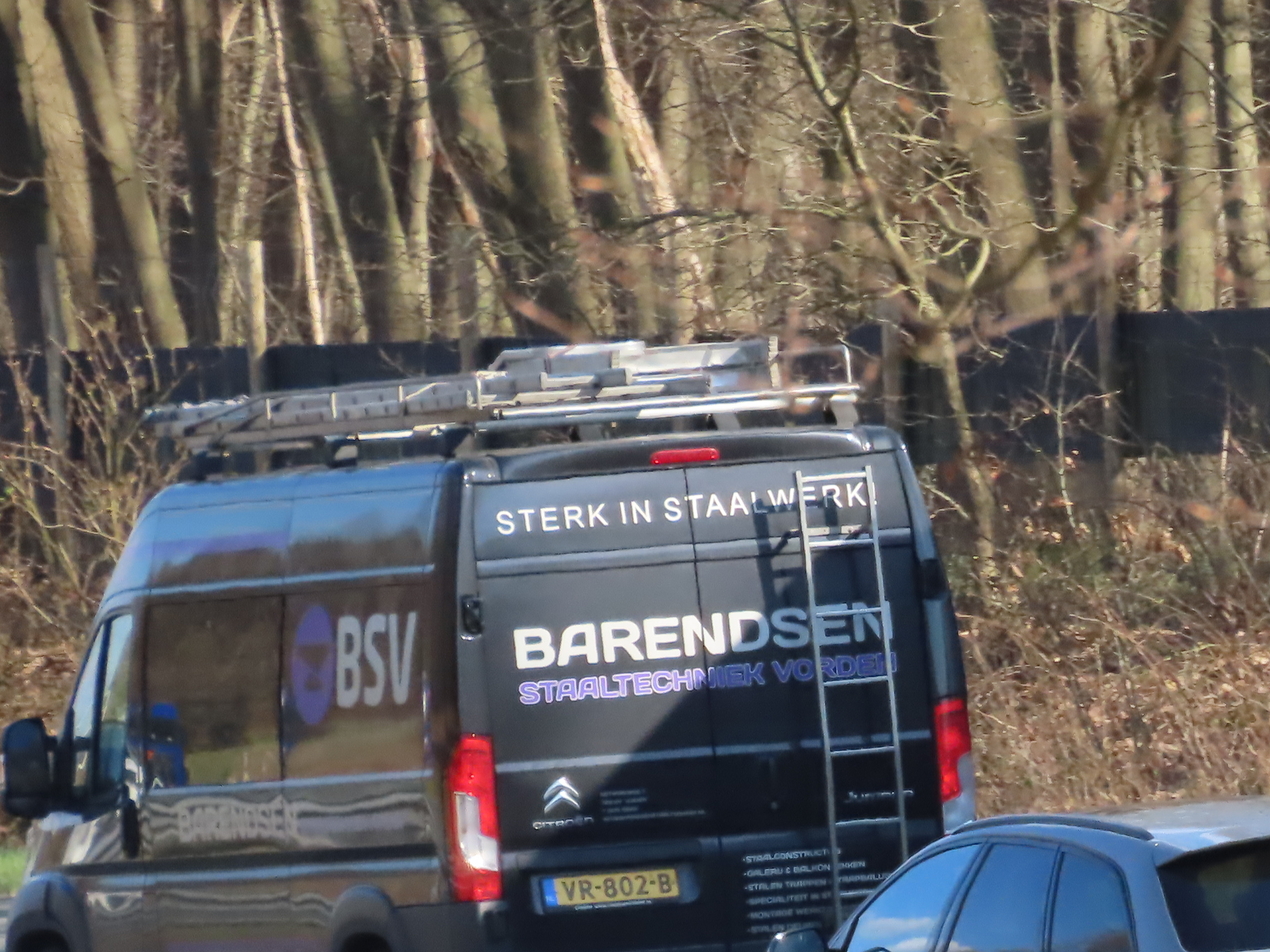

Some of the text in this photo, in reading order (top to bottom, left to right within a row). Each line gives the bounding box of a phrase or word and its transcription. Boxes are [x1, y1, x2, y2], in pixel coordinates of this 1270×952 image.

[497, 504, 609, 536] STERK
[620, 499, 652, 526] IN
[336, 611, 417, 709] BSV
[513, 600, 893, 670] BARENDSEN
[518, 651, 897, 706] STAALTECHNIEK VORDEN
[561, 872, 672, 902] VR-802-B
